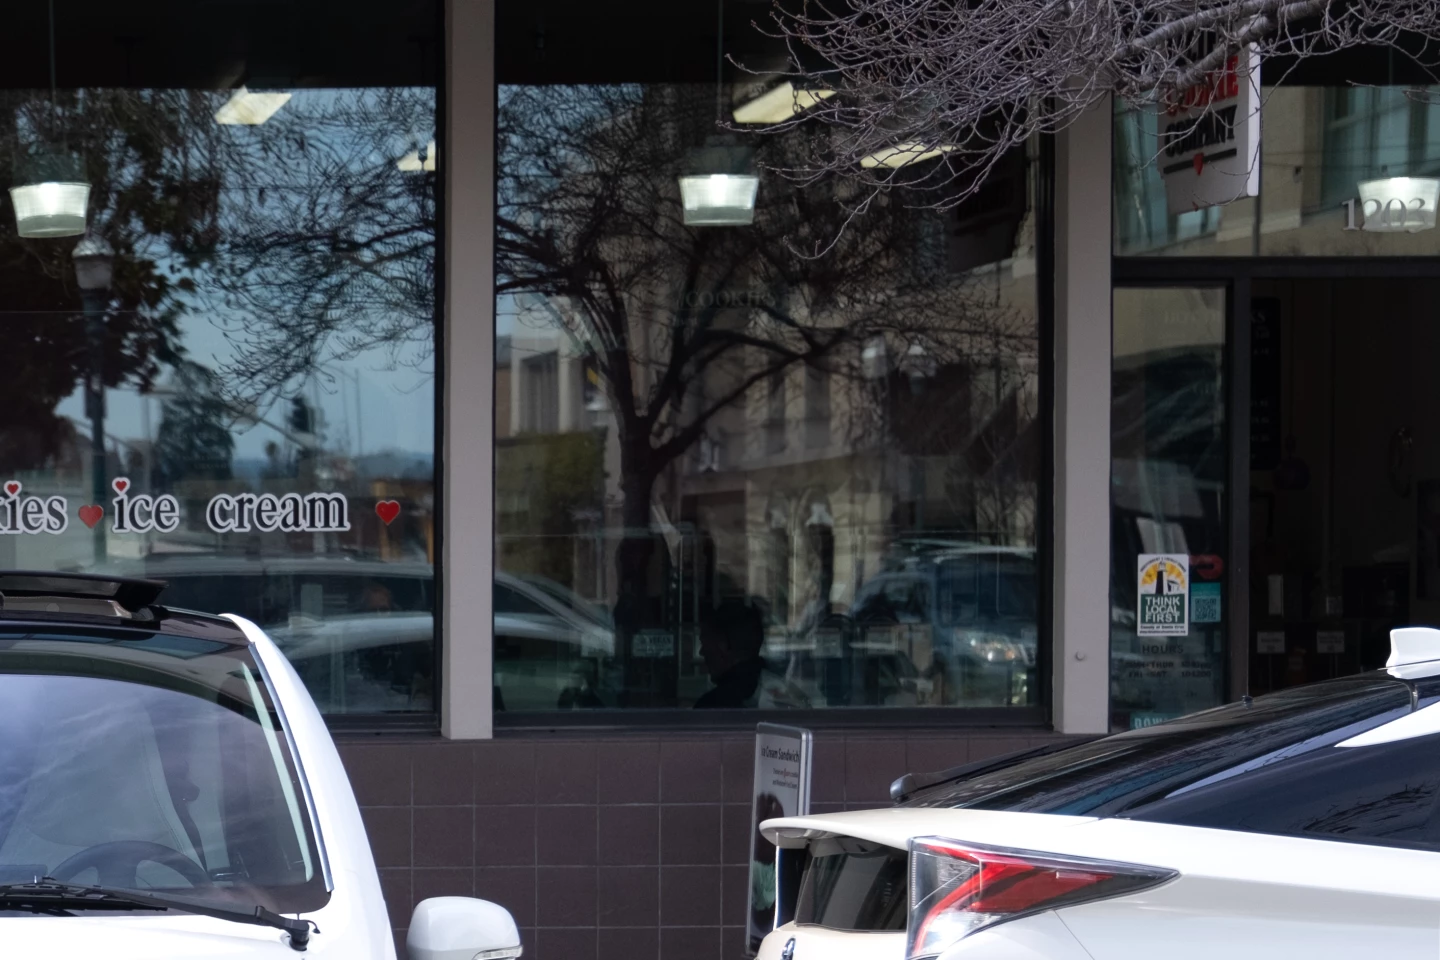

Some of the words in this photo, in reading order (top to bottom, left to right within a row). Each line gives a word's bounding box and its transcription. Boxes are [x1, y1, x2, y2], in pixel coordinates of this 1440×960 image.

[1165, 104, 1238, 158] COMPANY
[1341, 197, 1429, 233] 1203
[112, 477, 179, 533] ice
[206, 493, 351, 533] cream
[1145, 596, 1180, 606] THINK
[1145, 604, 1179, 615] LOCAL
[1145, 612, 1180, 623] FIRST
[1142, 644, 1184, 654] HOURS
